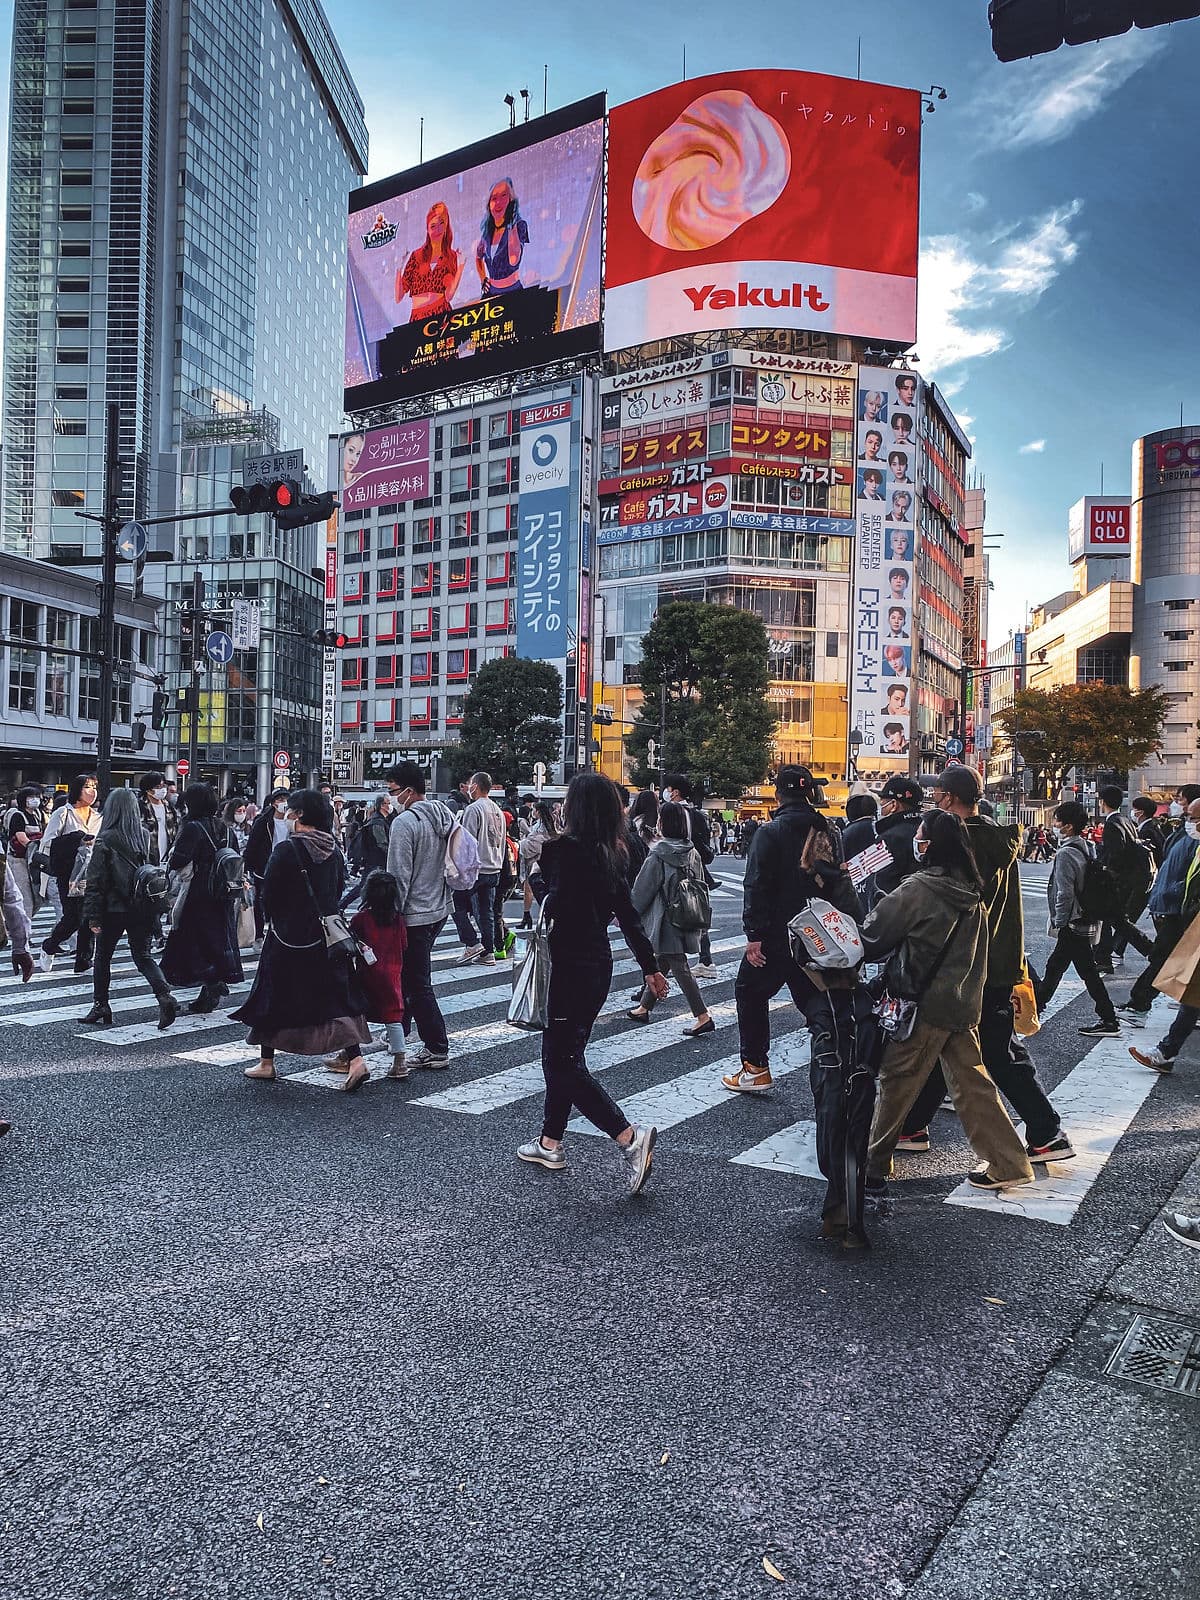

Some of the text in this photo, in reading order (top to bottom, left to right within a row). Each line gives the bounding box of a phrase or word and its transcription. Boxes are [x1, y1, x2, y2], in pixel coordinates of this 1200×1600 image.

[683, 282, 830, 312] Yakult
[651, 381, 704, 411] しゃぶ葉
[791, 380, 851, 406] しゃぶ葉
[525, 403, 566, 424] 当ビル5F
[604, 404, 620, 419] 9F
[380, 428, 426, 449] 品川スキン
[623, 430, 705, 463] プライス
[732, 425, 827, 452] コンタクト
[380, 443, 420, 463] クリニック
[247, 455, 298, 477] 渋谷駅前
[525, 466, 564, 485] eyecity
[671, 463, 713, 486] ガスト
[799, 464, 844, 485] ガスト
[354, 474, 425, 503] 品川美容外科
[707, 492, 726, 502] ガスト
[601, 505, 620, 521] 7F
[623, 501, 645, 514] Café
[647, 492, 698, 520] ガスト
[736, 514, 853, 533] AEON 英会話イーオン
[1095, 510, 1124, 524] UNI
[600, 529, 623, 541] AEON
[631, 518, 705, 538] 英会話イーオン
[861, 512, 871, 545] JAPAN
[1094, 526, 1126, 541] QLO
[871, 514, 882, 570] SEVENTEEN
[523, 513, 545, 633] アイシティ
[545, 510, 562, 632] コンタクトの
[861, 557, 870, 570] EP
[174, 600, 223, 610] MRK
[204, 591, 244, 599] HIBUYA
[856, 587, 880, 693] DREAM
[864, 710, 876, 746] 11/9
[370, 747, 444, 768] サンドラッグ
